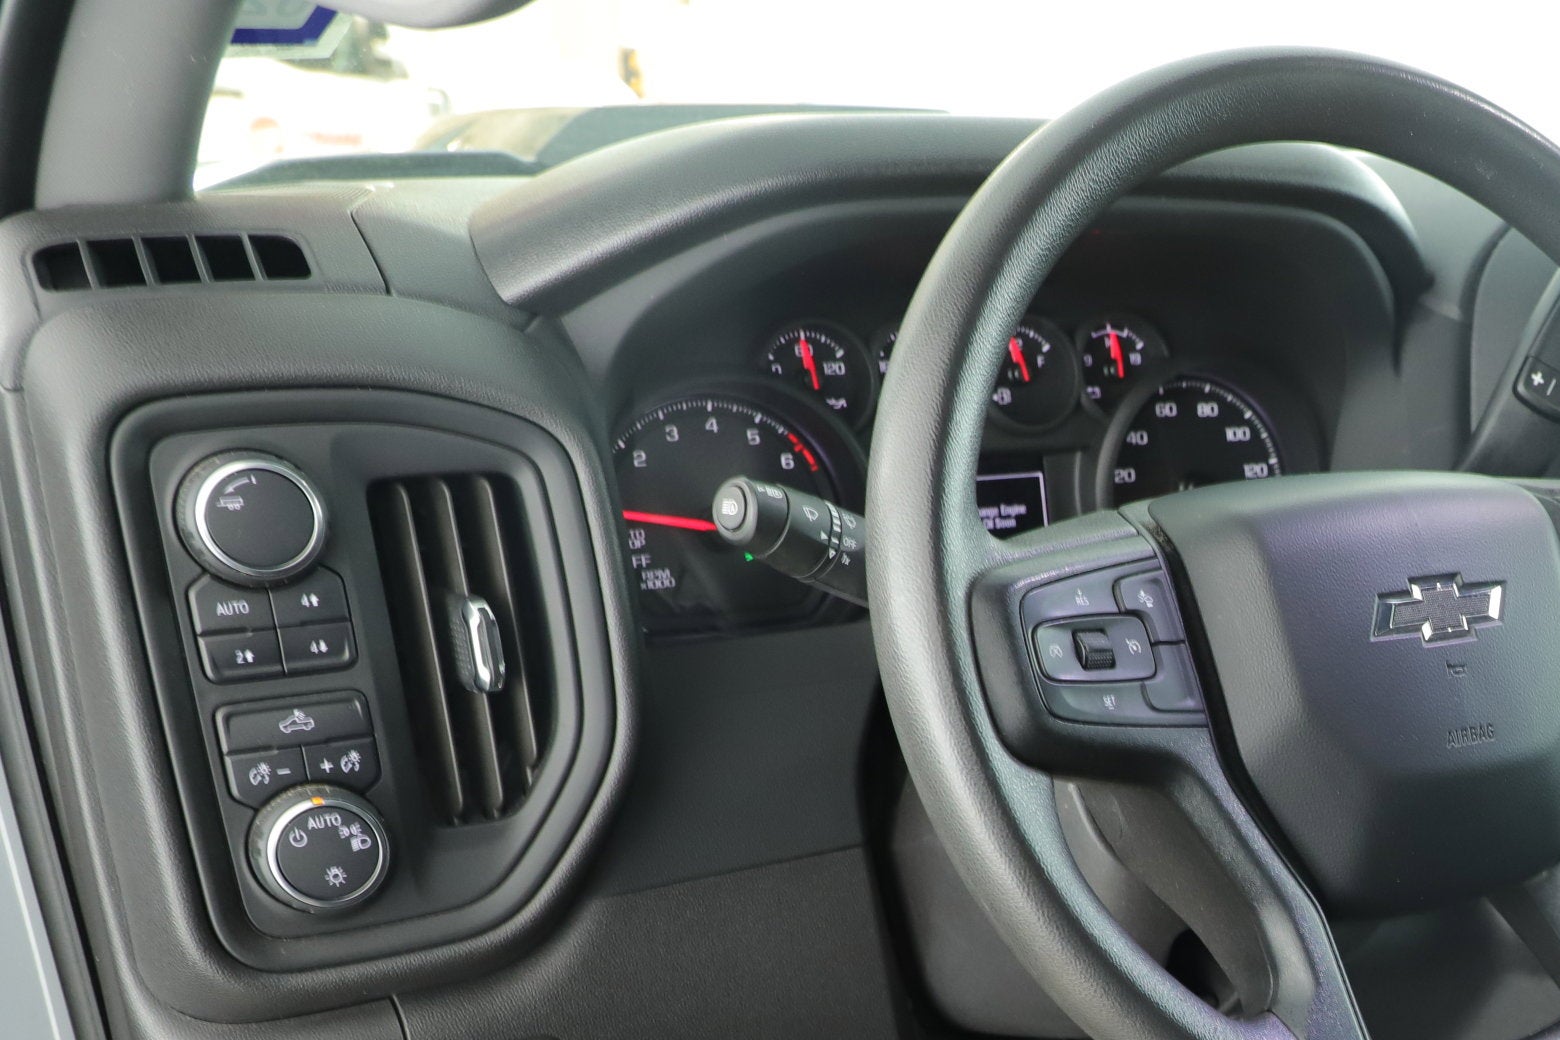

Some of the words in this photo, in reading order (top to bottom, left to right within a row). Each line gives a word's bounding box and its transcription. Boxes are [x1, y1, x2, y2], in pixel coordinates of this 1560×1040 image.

[823, 361, 846, 375] 120
[1037, 354, 1045, 368] F
[1155, 402, 1178, 418] 60
[1197, 402, 1219, 418] 80
[705, 416, 719, 433] 4
[665, 425, 680, 442] 3
[747, 428, 760, 445] 5
[1126, 430, 1148, 446] 40
[1225, 426, 1251, 442] 100
[633, 452, 647, 468] 2
[781, 453, 795, 470] 6
[1114, 468, 1136, 483] 20
[1243, 463, 1268, 478] 120
[843, 536, 857, 550] OFF
[642, 568, 671, 580] RPM
[216, 600, 250, 616] AUTO
[1075, 594, 1090, 606] RES
[1102, 695, 1116, 707] SET
[1446, 722, 1495, 748] AIRBAG
[306, 814, 342, 830] AUTO
